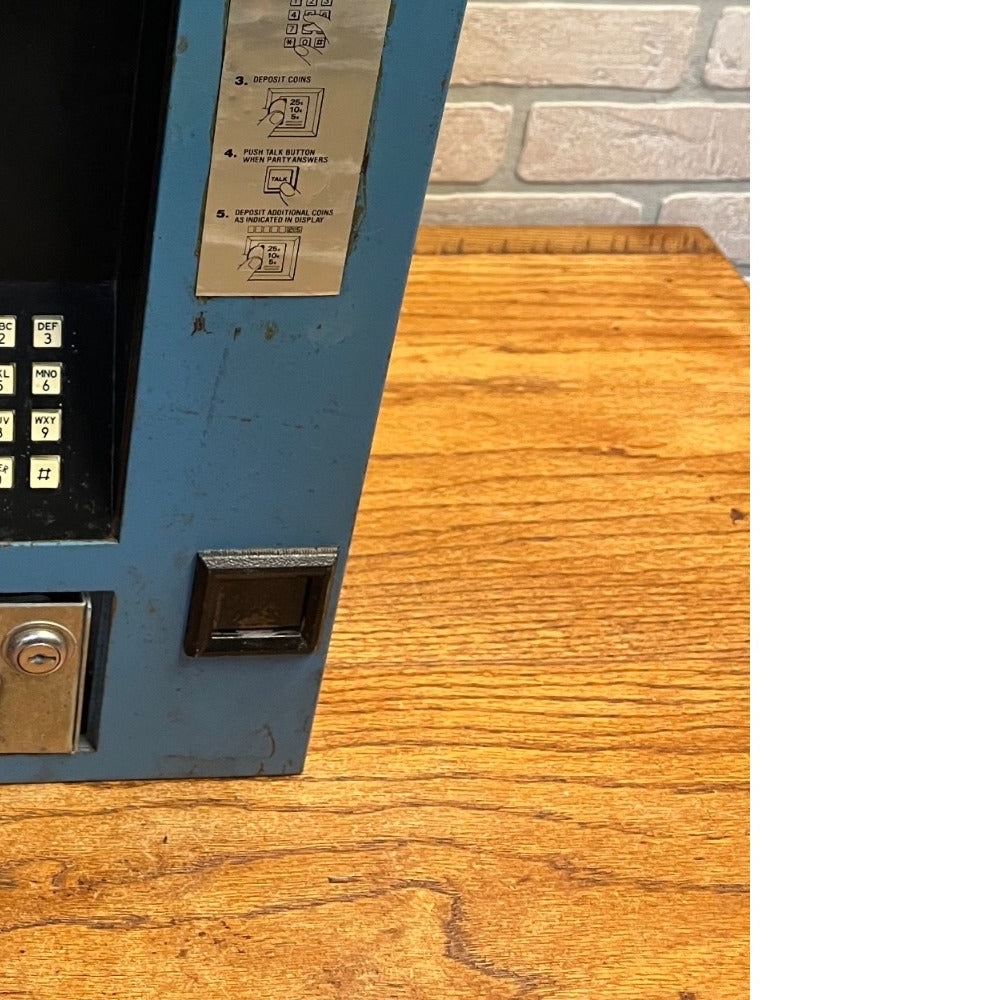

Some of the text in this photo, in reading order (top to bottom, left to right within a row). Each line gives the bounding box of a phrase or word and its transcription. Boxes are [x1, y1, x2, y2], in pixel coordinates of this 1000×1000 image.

[235, 76, 248, 86] 3.
[253, 75, 286, 84] DEPOSIT
[224, 149, 237, 158] 4.
[216, 209, 229, 218] 5.
[38, 322, 58, 331] DEF
[44, 333, 52, 344] 3
[35, 370, 57, 378] MNO
[42, 380, 50, 391] 6
[34, 417, 57, 425] WXY
[41, 427, 49, 438] 9
